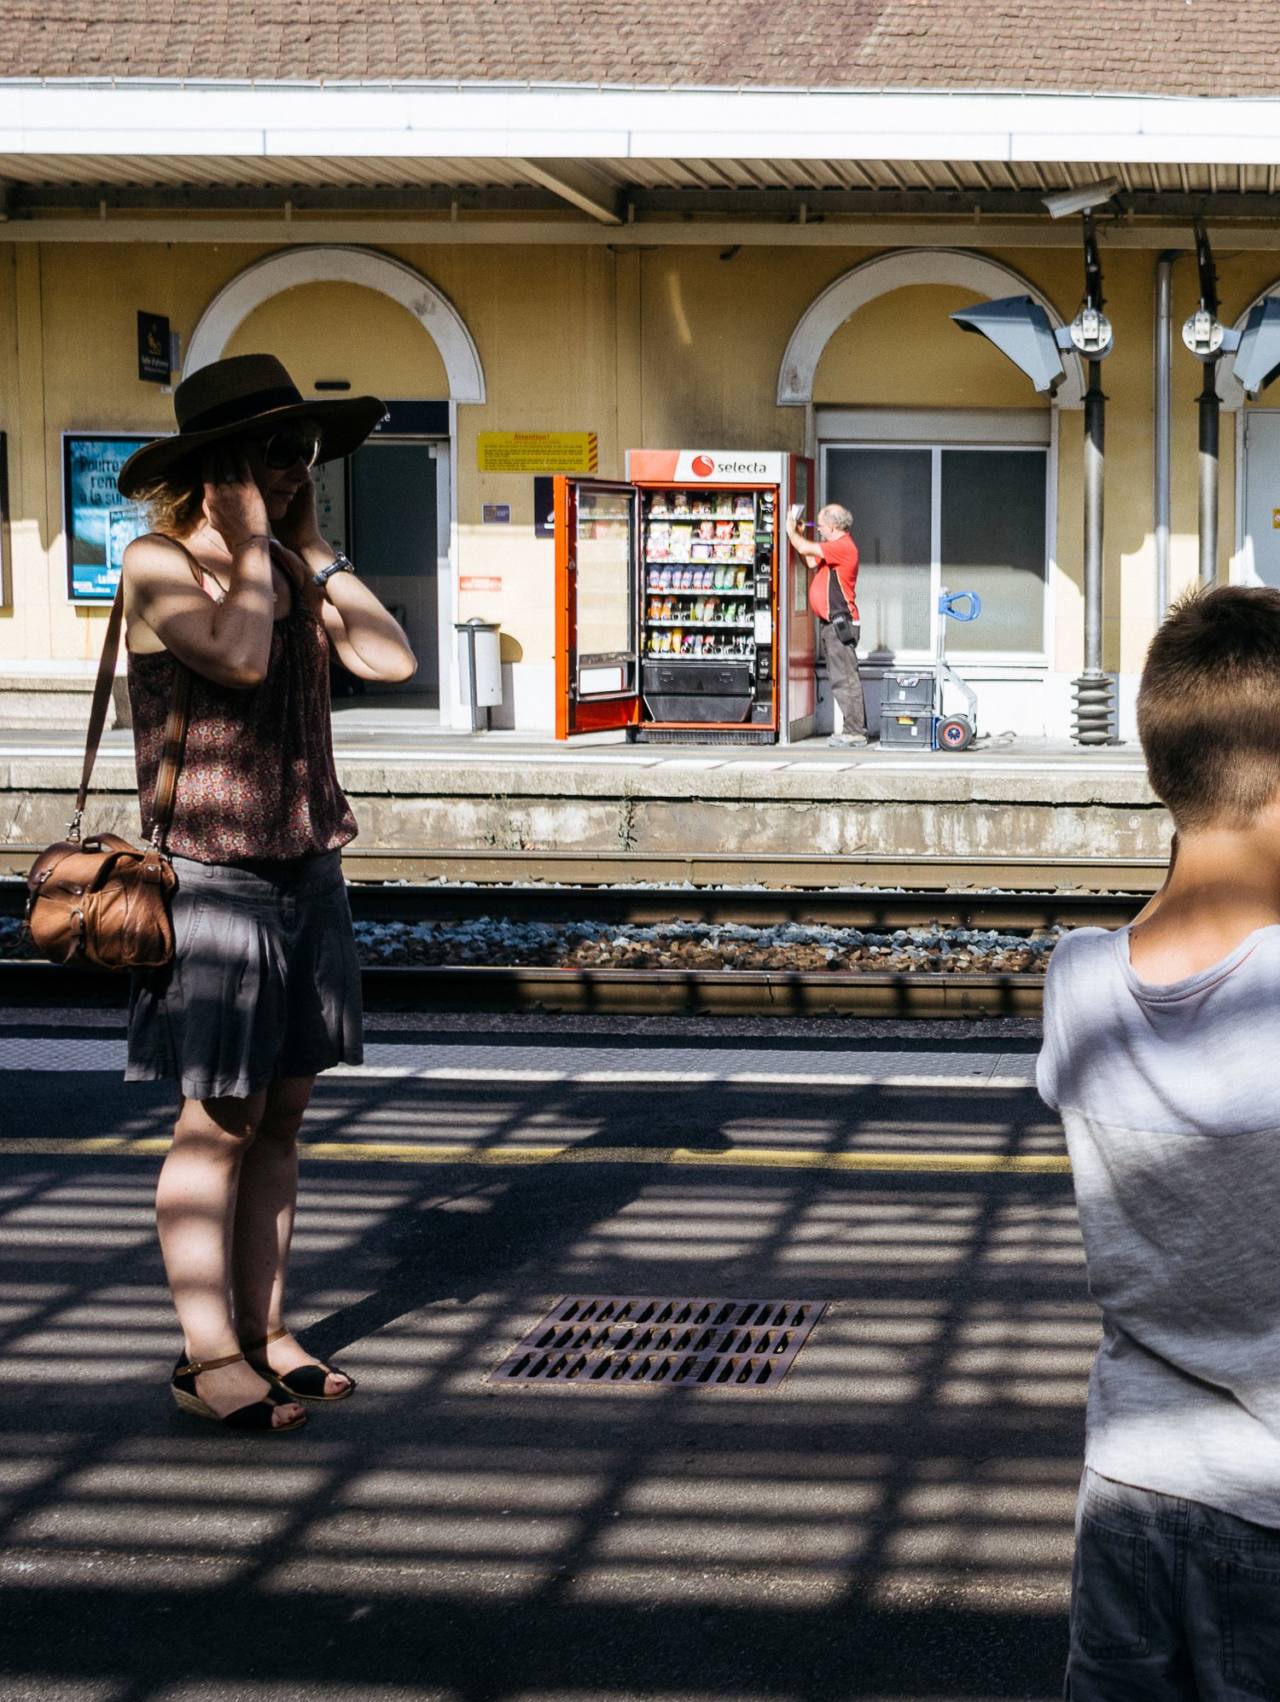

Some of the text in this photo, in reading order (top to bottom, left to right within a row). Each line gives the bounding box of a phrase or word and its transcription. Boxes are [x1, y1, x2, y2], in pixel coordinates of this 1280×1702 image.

[717, 462, 767, 474] selecta
[91, 476, 118, 489] rem
[91, 490, 101, 505] la
